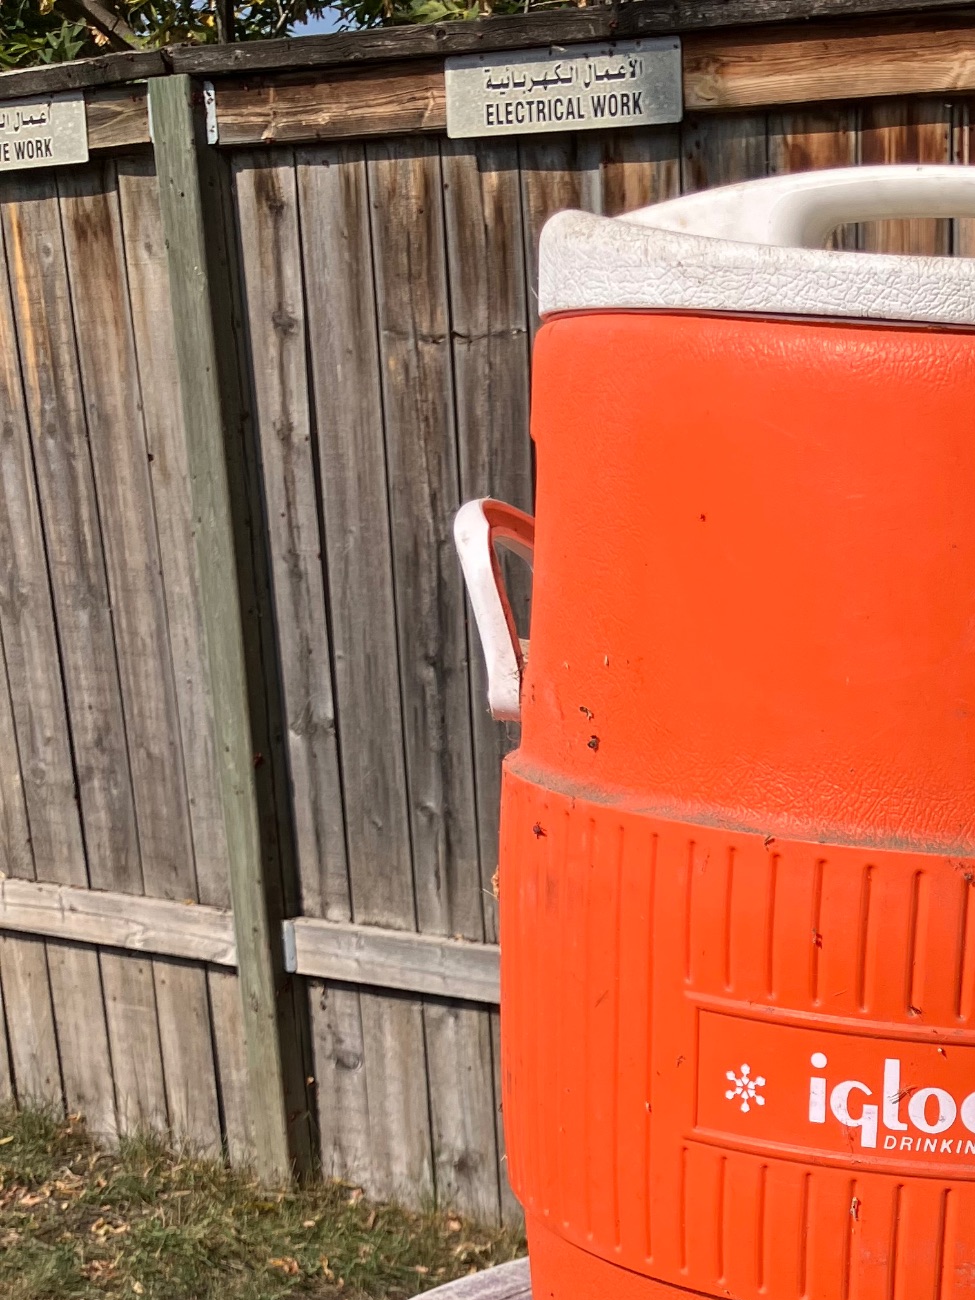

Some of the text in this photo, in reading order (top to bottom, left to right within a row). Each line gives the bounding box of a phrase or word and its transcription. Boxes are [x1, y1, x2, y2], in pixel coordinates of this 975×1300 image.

[486, 91, 643, 126] ELECTRICAL WORK
[14, 138, 53, 160] WORK
